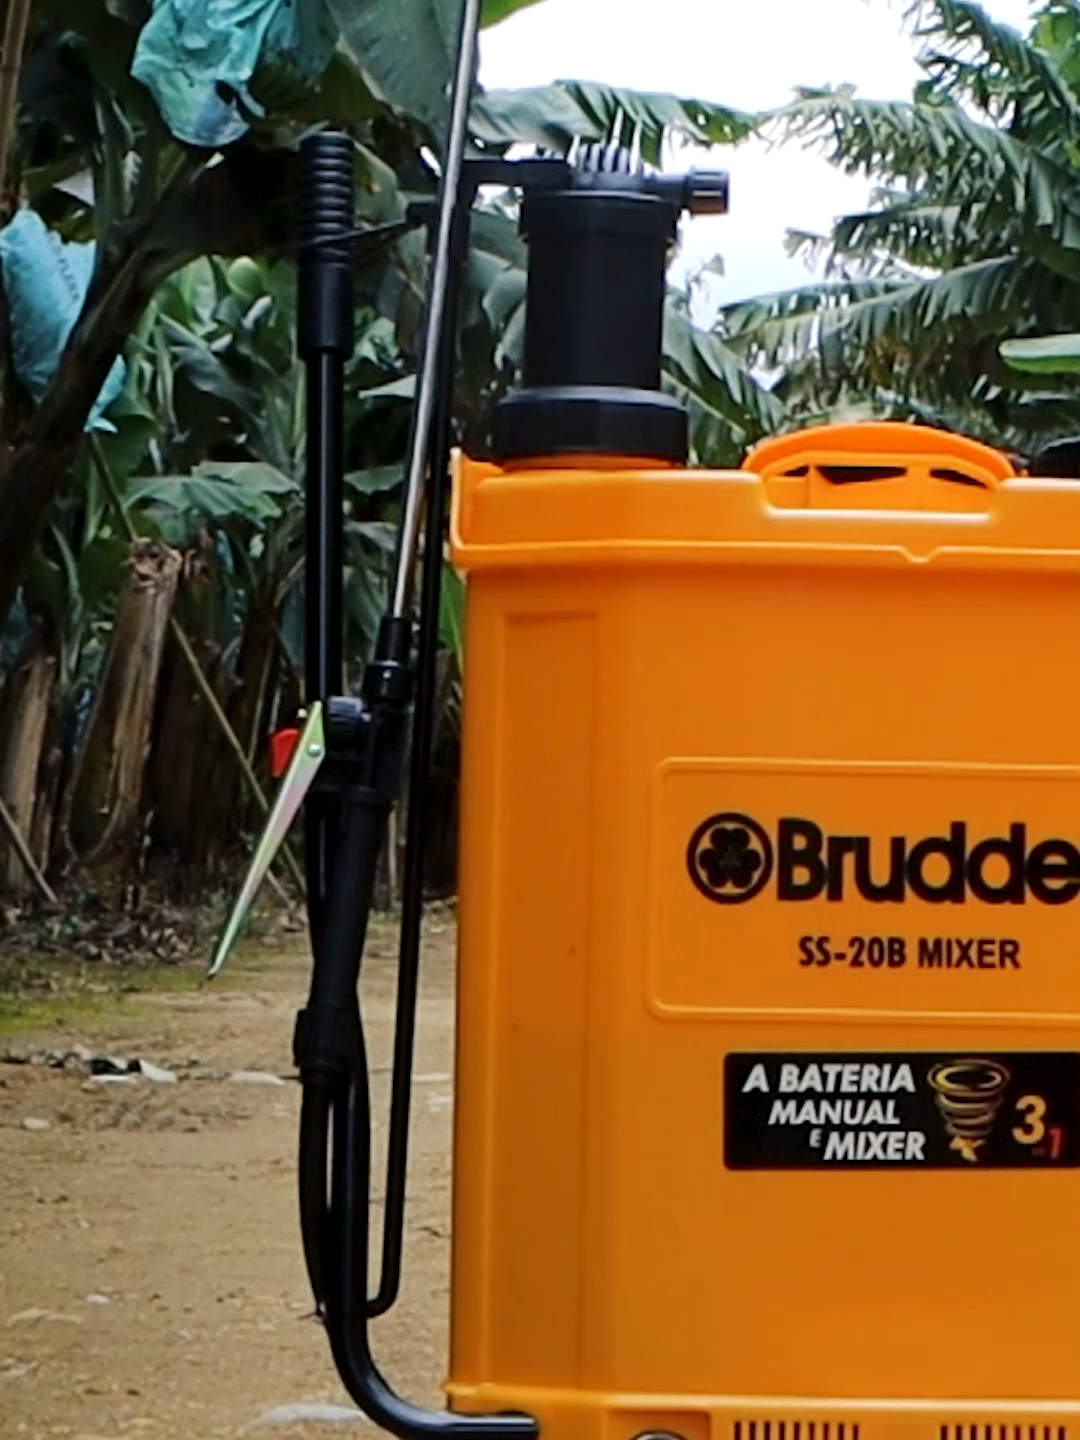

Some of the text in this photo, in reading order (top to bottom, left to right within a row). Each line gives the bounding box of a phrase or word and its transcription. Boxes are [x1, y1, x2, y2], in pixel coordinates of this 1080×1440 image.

[798, 935, 1021, 970] SS-20B MIXER
[742, 1063, 917, 1094] A BATERIA
[767, 1099, 901, 1126] MANUAL
[1012, 1094, 1063, 1160] 3 1
[809, 1128, 927, 1162] E MIXER
